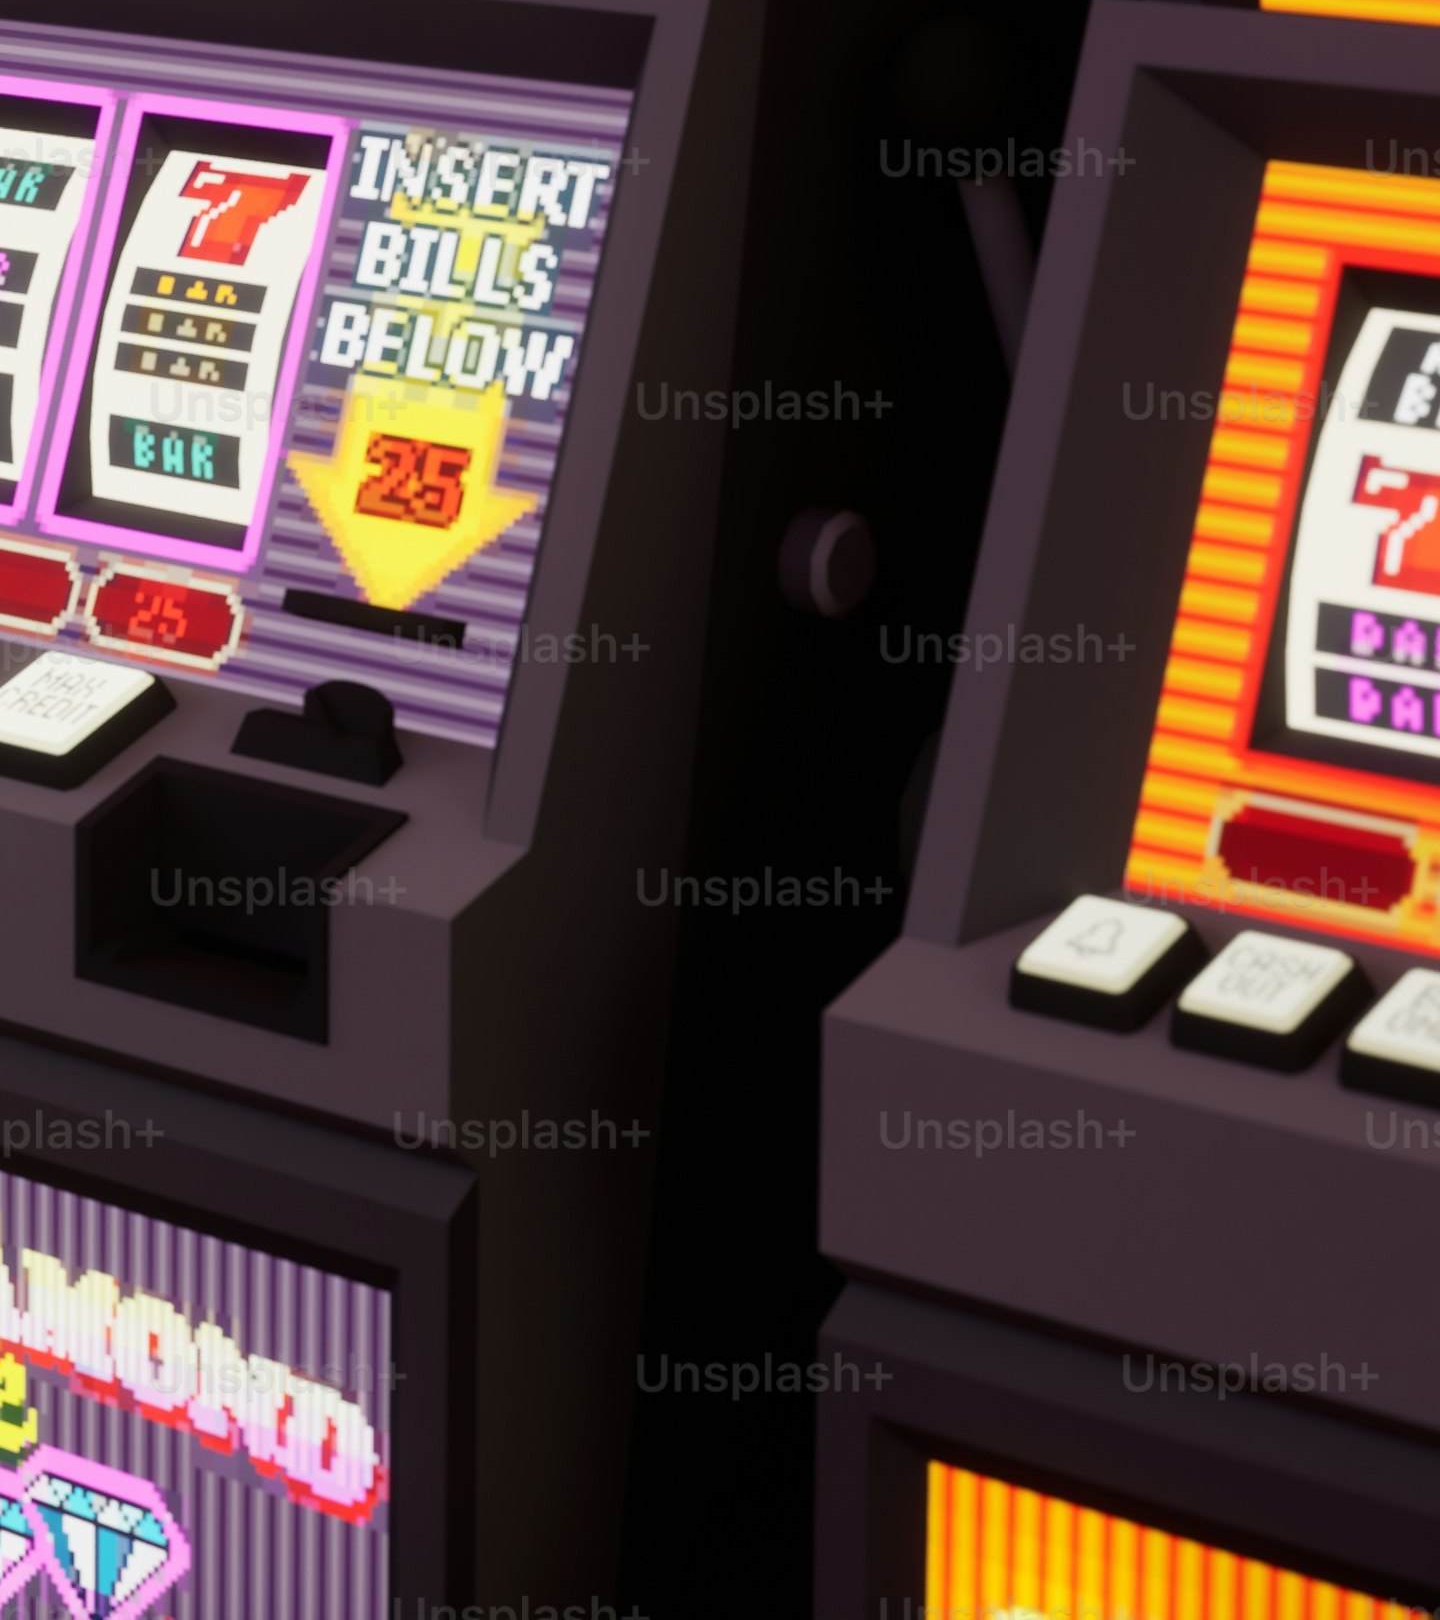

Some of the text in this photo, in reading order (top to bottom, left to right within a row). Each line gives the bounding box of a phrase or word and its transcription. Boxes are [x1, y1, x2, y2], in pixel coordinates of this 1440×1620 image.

[180, 160, 312, 266] 7
[350, 135, 610, 228] INSERT
[356, 221, 558, 310] BILLS
[320, 302, 574, 401] BELOW
[134, 428, 213, 481] BAR
[353, 432, 473, 529] 25
[129, 585, 189, 642] 25
[32, 666, 110, 699] MAX
